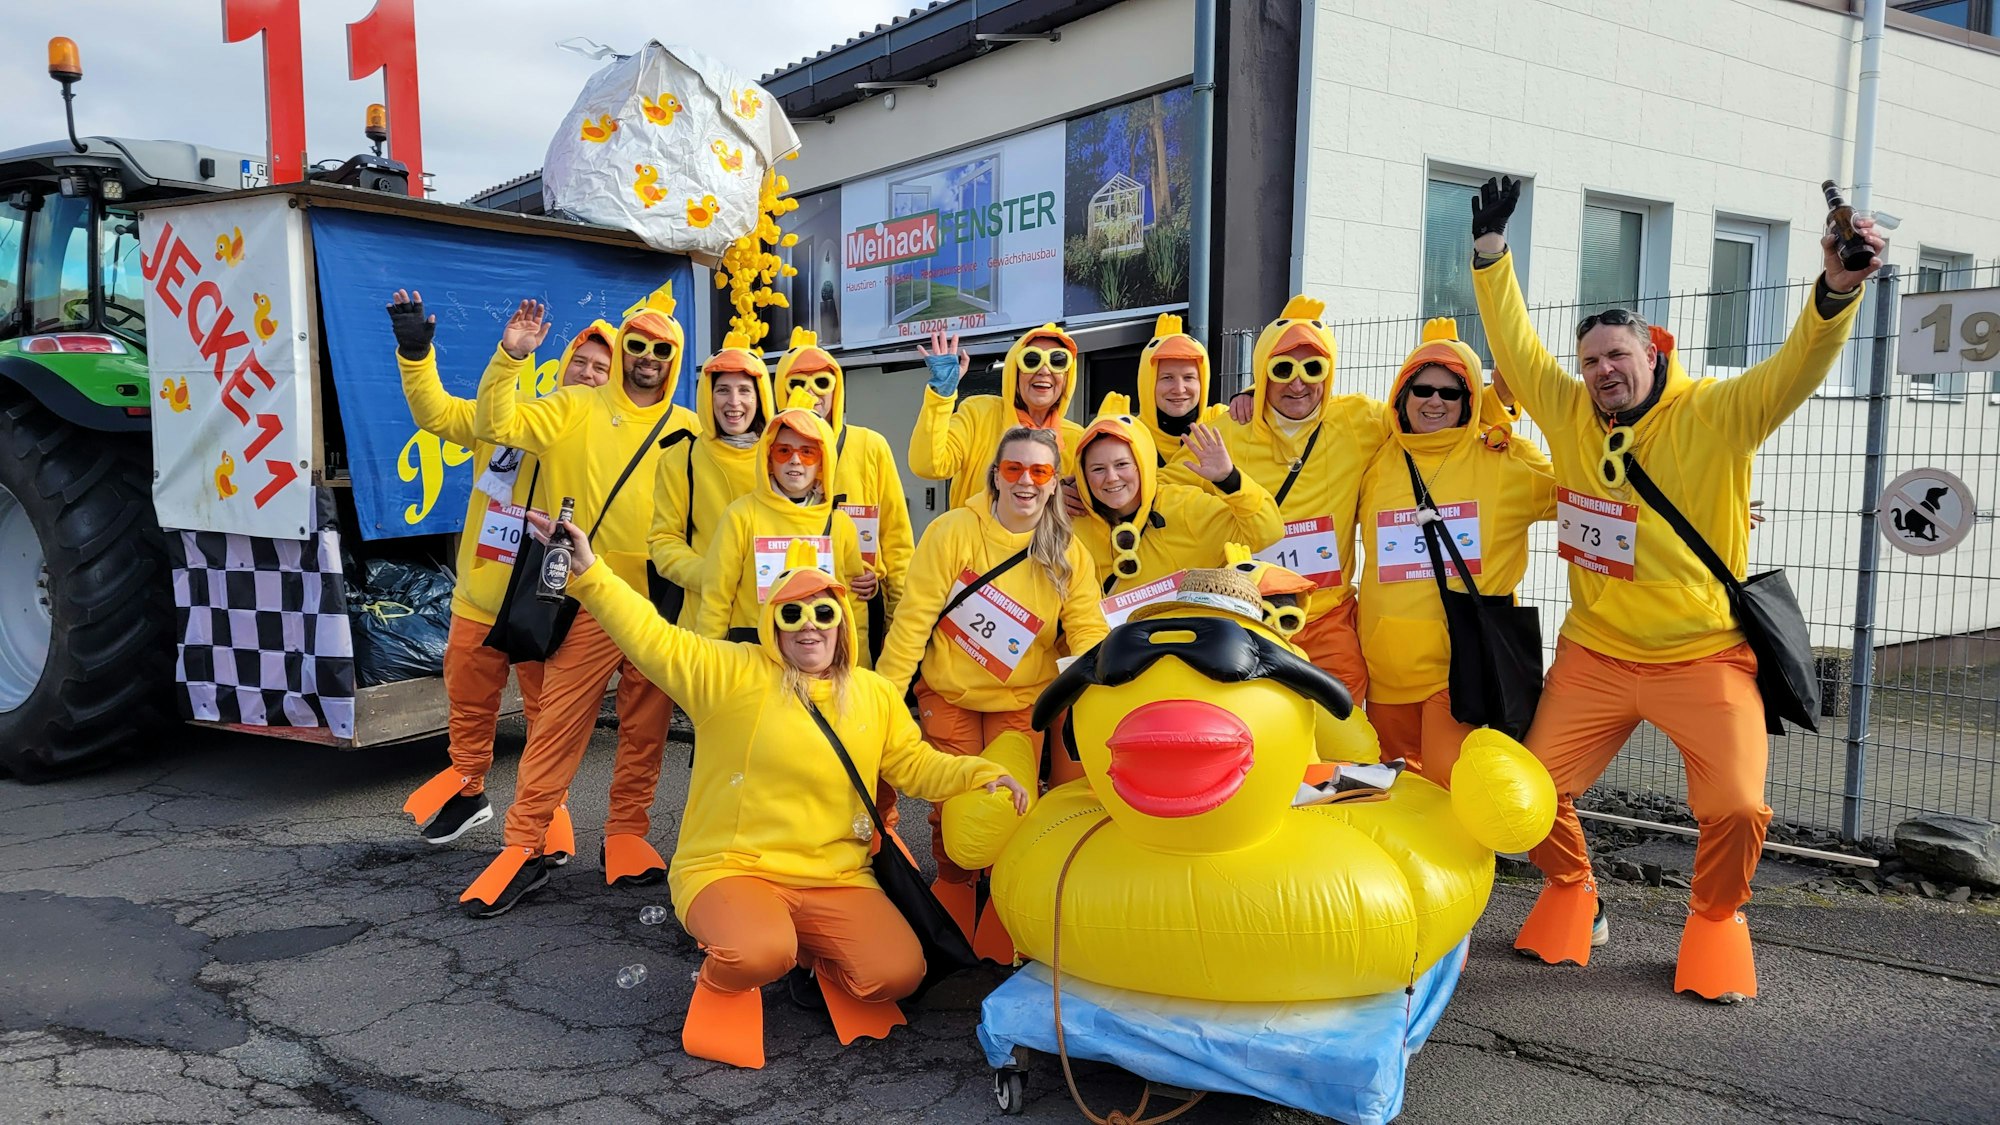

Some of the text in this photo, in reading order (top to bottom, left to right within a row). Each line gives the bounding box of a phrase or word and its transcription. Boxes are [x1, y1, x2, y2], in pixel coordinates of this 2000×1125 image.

[221, 0, 424, 199] 11
[848, 190, 1056, 266] Meihack FENSTER
[846, 279, 877, 292] Haustüren
[987, 249, 1057, 269] Gewächshausbau
[898, 324, 916, 336] Tel.:
[920, 319, 948, 334] 02204
[959, 314, 986, 330] 71071
[1921, 303, 2000, 361] 19
[1568, 491, 1623, 516] ENTENRENNEN
[500, 526, 520, 544] 10
[1580, 523, 1601, 547] 73
[1277, 549, 1298, 567] 11
[1406, 568, 1453, 579] IMMEKEL
[979, 584, 1030, 623] TENRENNEN
[1115, 578, 1175, 608] ENTENRENNEN
[969, 612, 996, 639] 28
